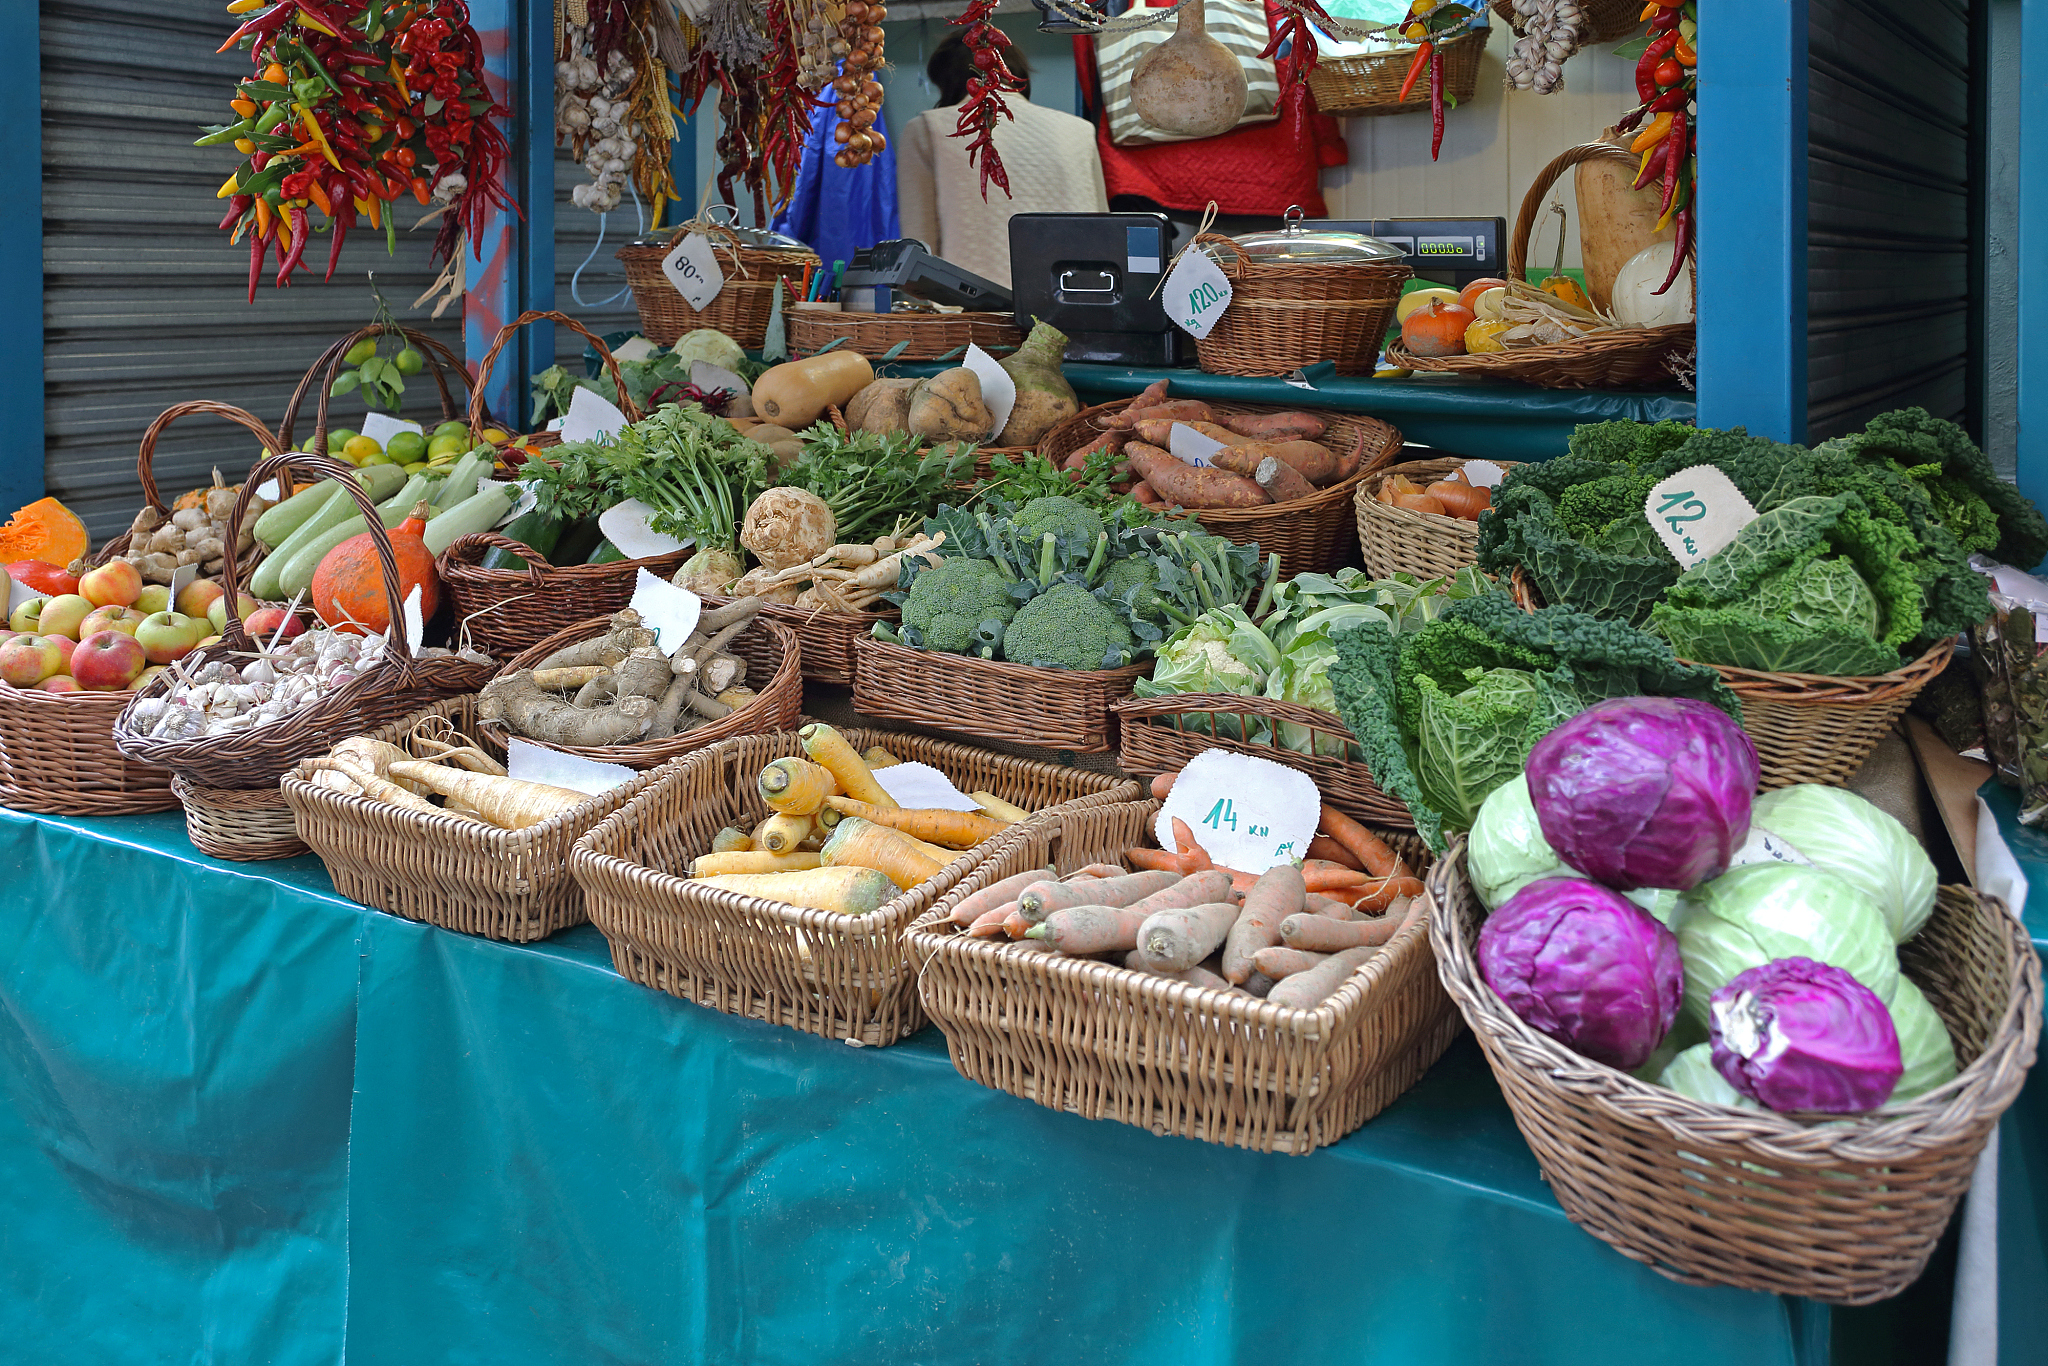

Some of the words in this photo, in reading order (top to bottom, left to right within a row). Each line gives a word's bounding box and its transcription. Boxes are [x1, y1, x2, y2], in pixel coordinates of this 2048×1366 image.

[675, 256, 696, 278] 80
[1189, 282, 1219, 315] 120
[1656, 490, 1706, 535] 12
[1202, 798, 1238, 832] 14
